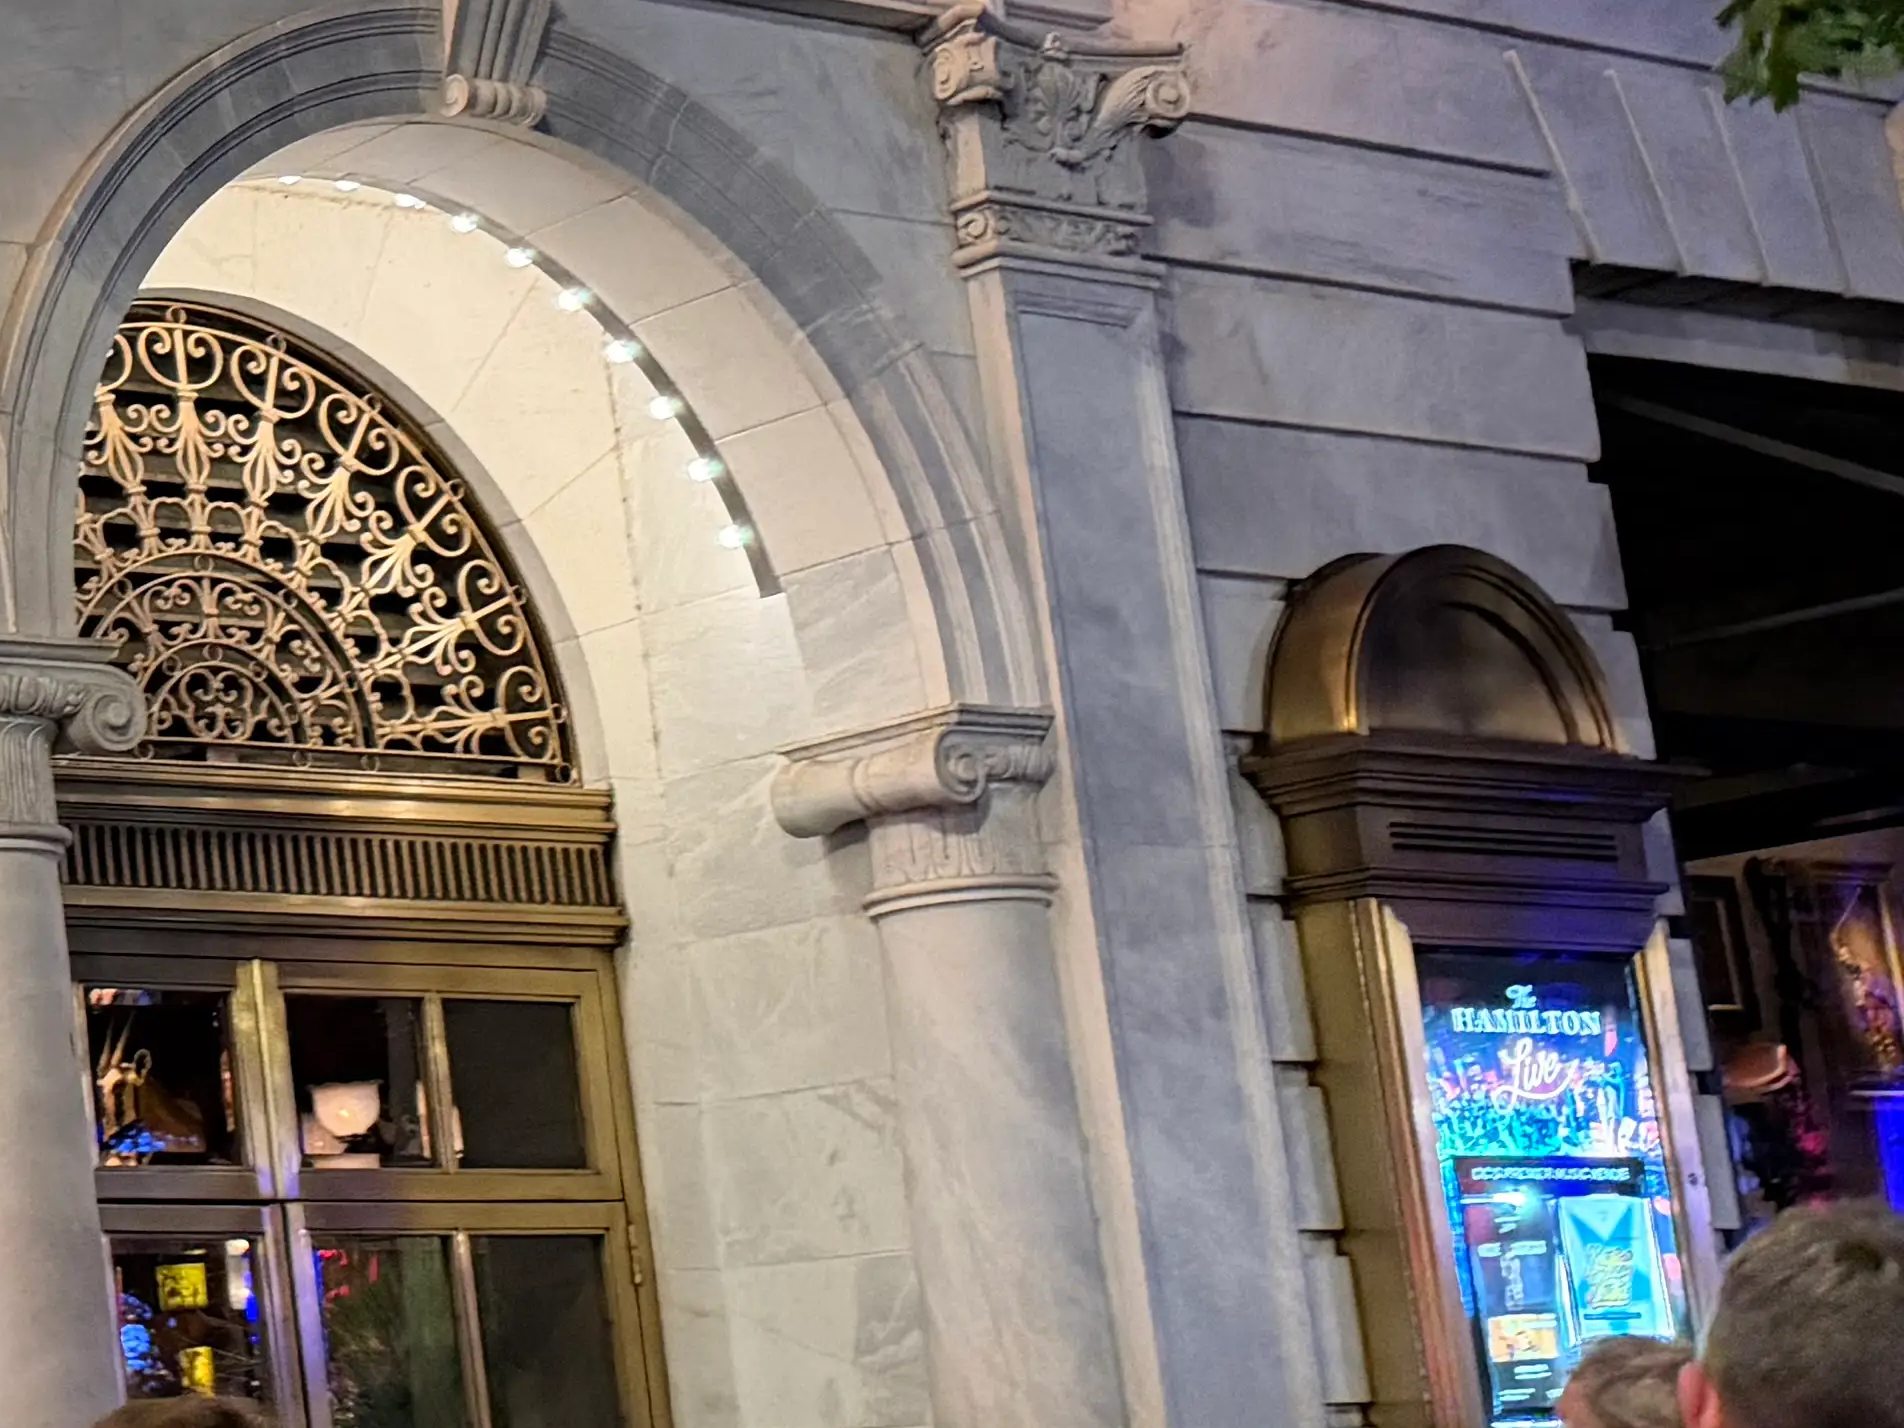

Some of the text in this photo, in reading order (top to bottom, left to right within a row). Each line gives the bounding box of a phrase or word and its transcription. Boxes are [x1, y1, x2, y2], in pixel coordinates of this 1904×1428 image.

[1505, 984, 1538, 1009] The
[1450, 1007, 1601, 1036] HAMILTON
[1492, 1037, 1580, 1115] Live
